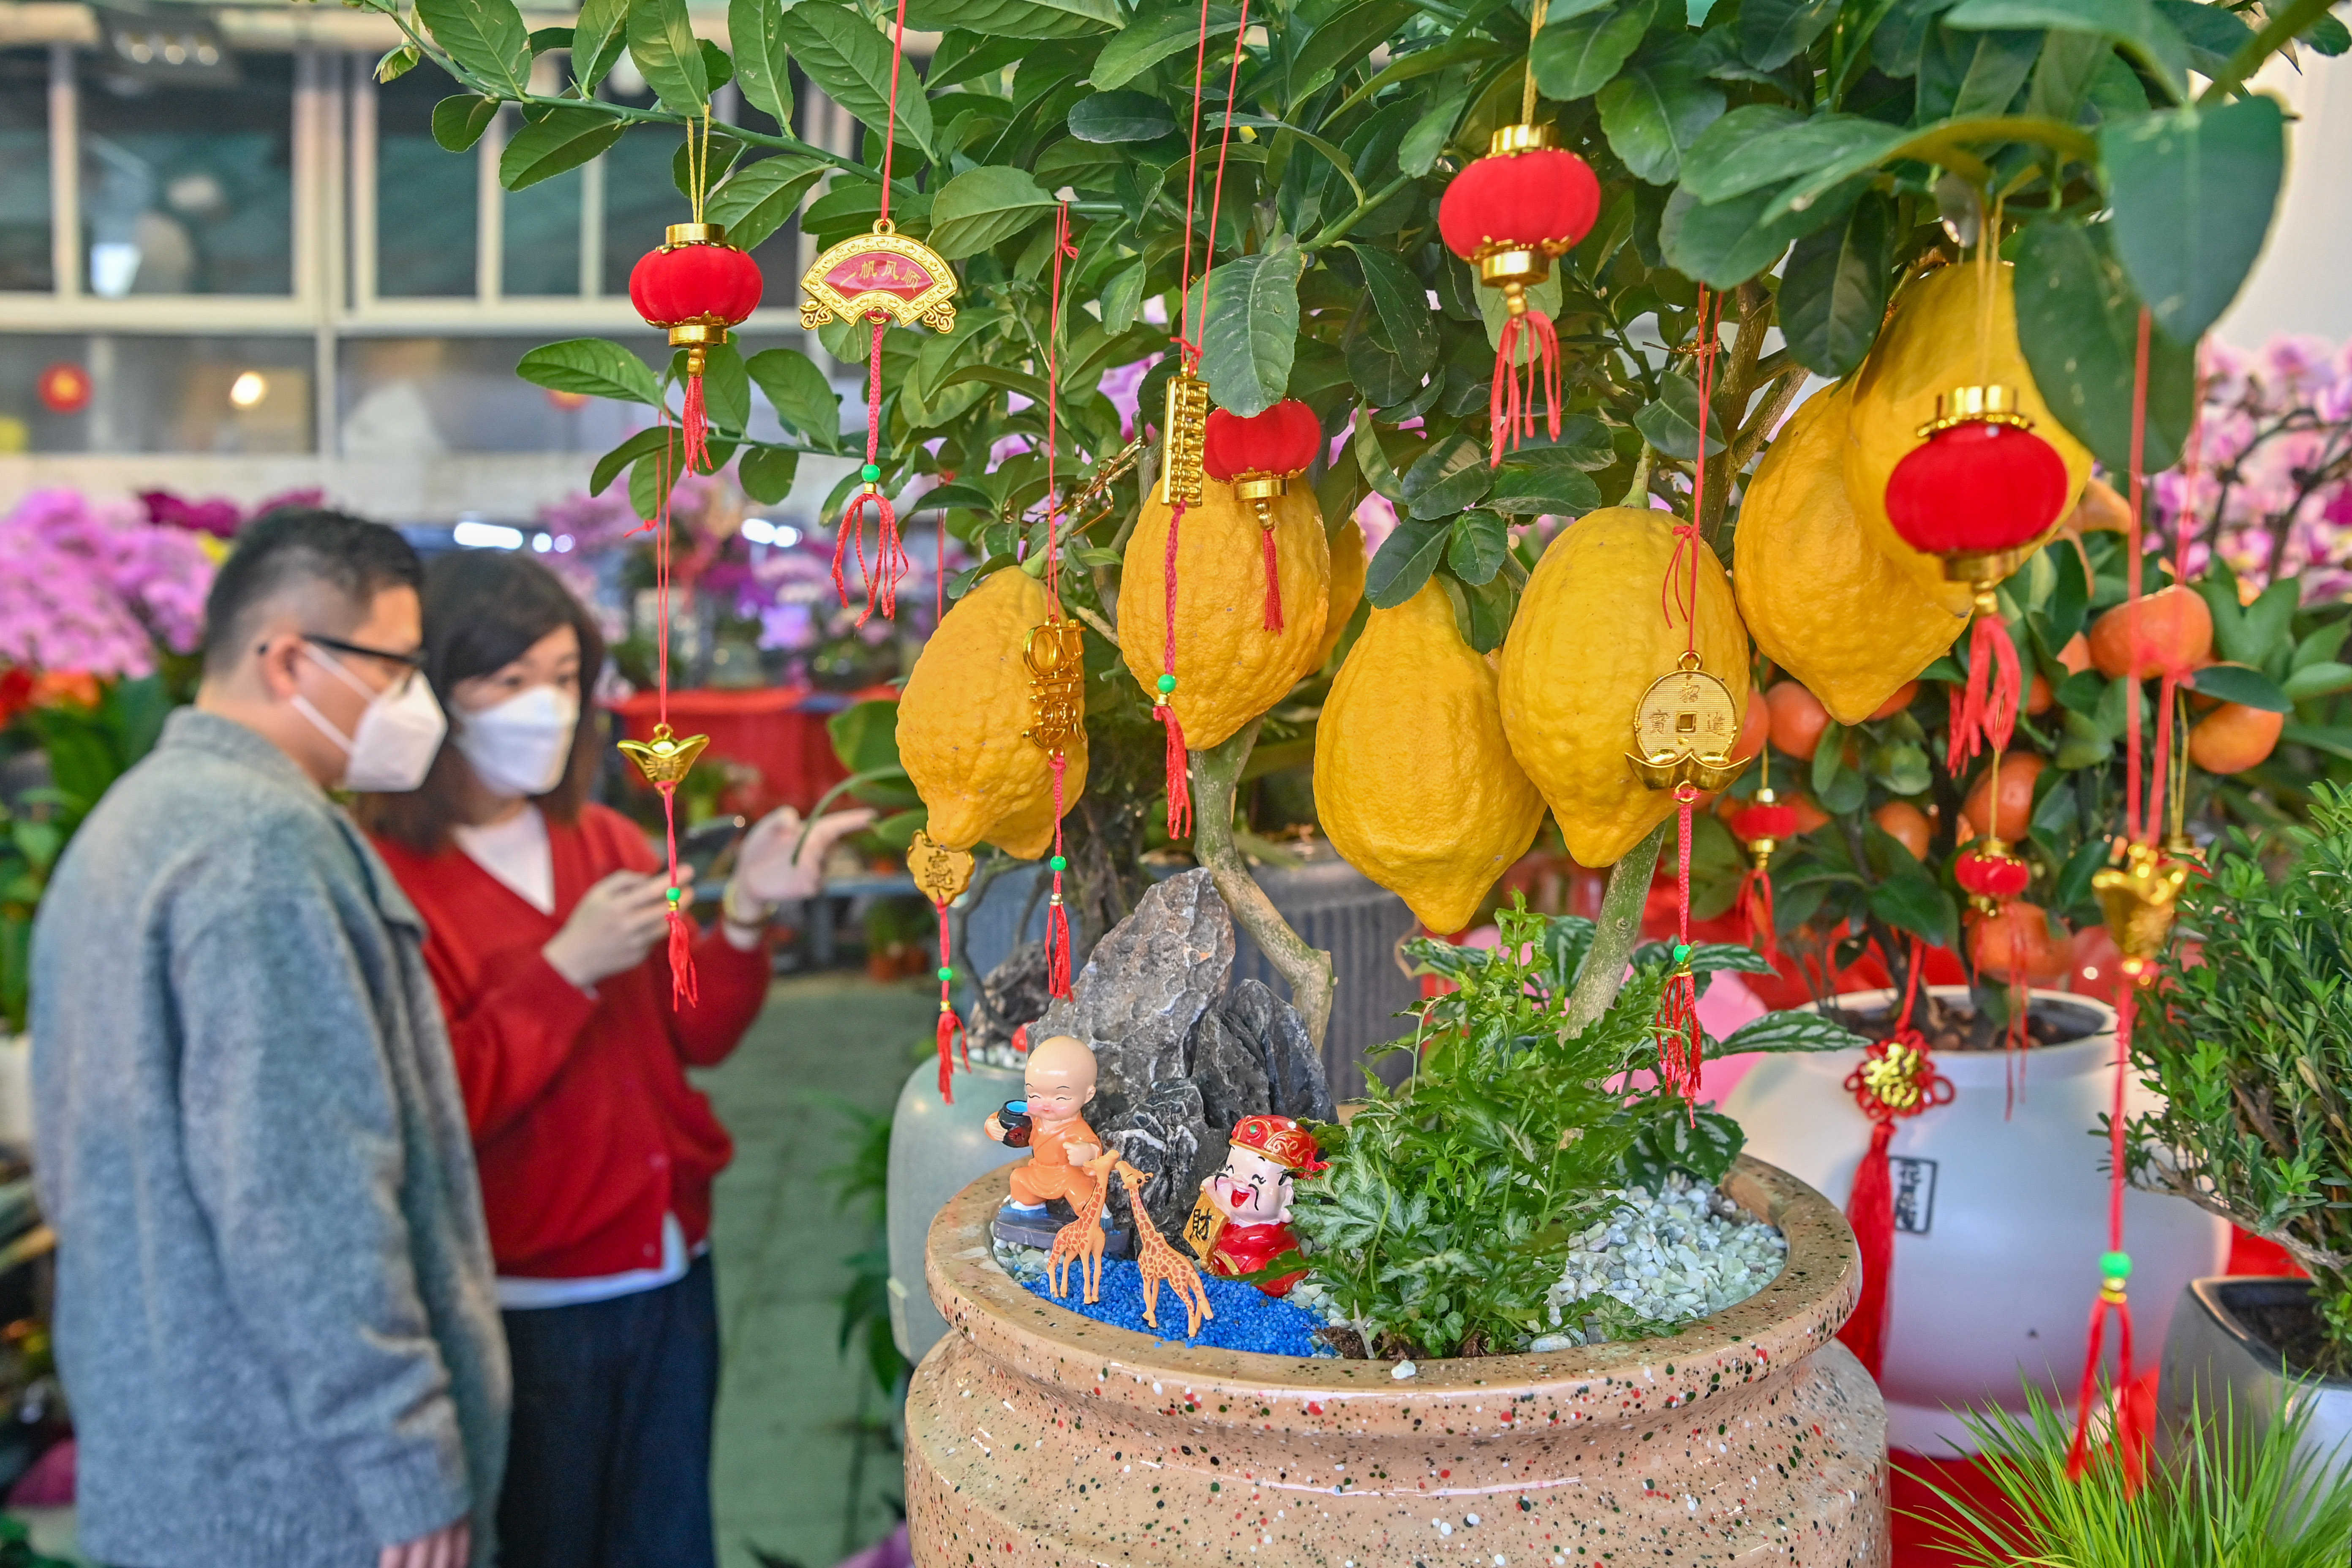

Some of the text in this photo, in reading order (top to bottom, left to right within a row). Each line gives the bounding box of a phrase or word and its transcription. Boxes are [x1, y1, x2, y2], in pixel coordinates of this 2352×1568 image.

[839, 260, 922, 293] 一帆风顺
[1189, 1208, 1215, 1241] 財
